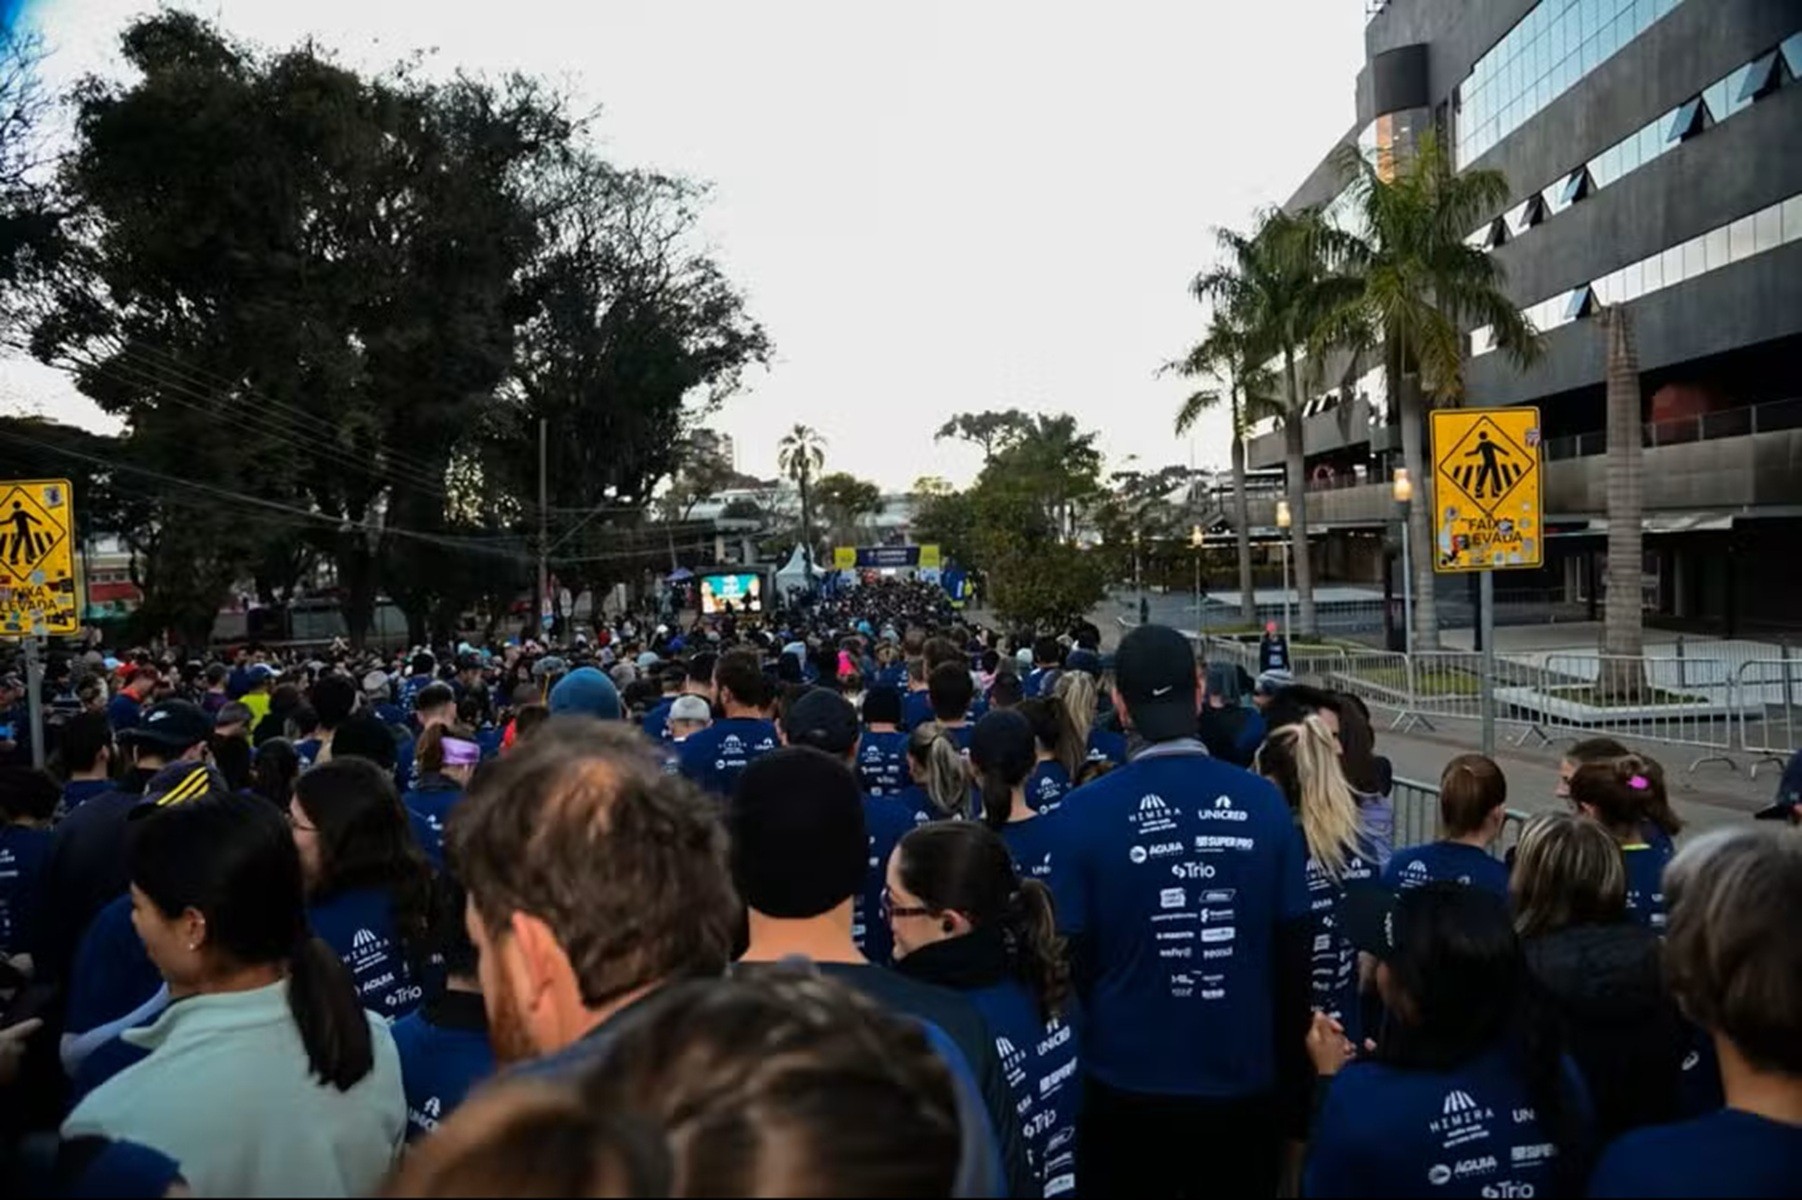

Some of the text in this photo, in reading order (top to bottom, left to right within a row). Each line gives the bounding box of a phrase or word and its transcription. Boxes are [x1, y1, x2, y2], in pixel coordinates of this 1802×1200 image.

[1466, 517, 1513, 532] FAIX
[1198, 809, 1249, 822] UNICRED
[1183, 860, 1217, 879] Trio
[395, 984, 422, 1004] Trio
[1496, 1180, 1535, 1199] Trio
